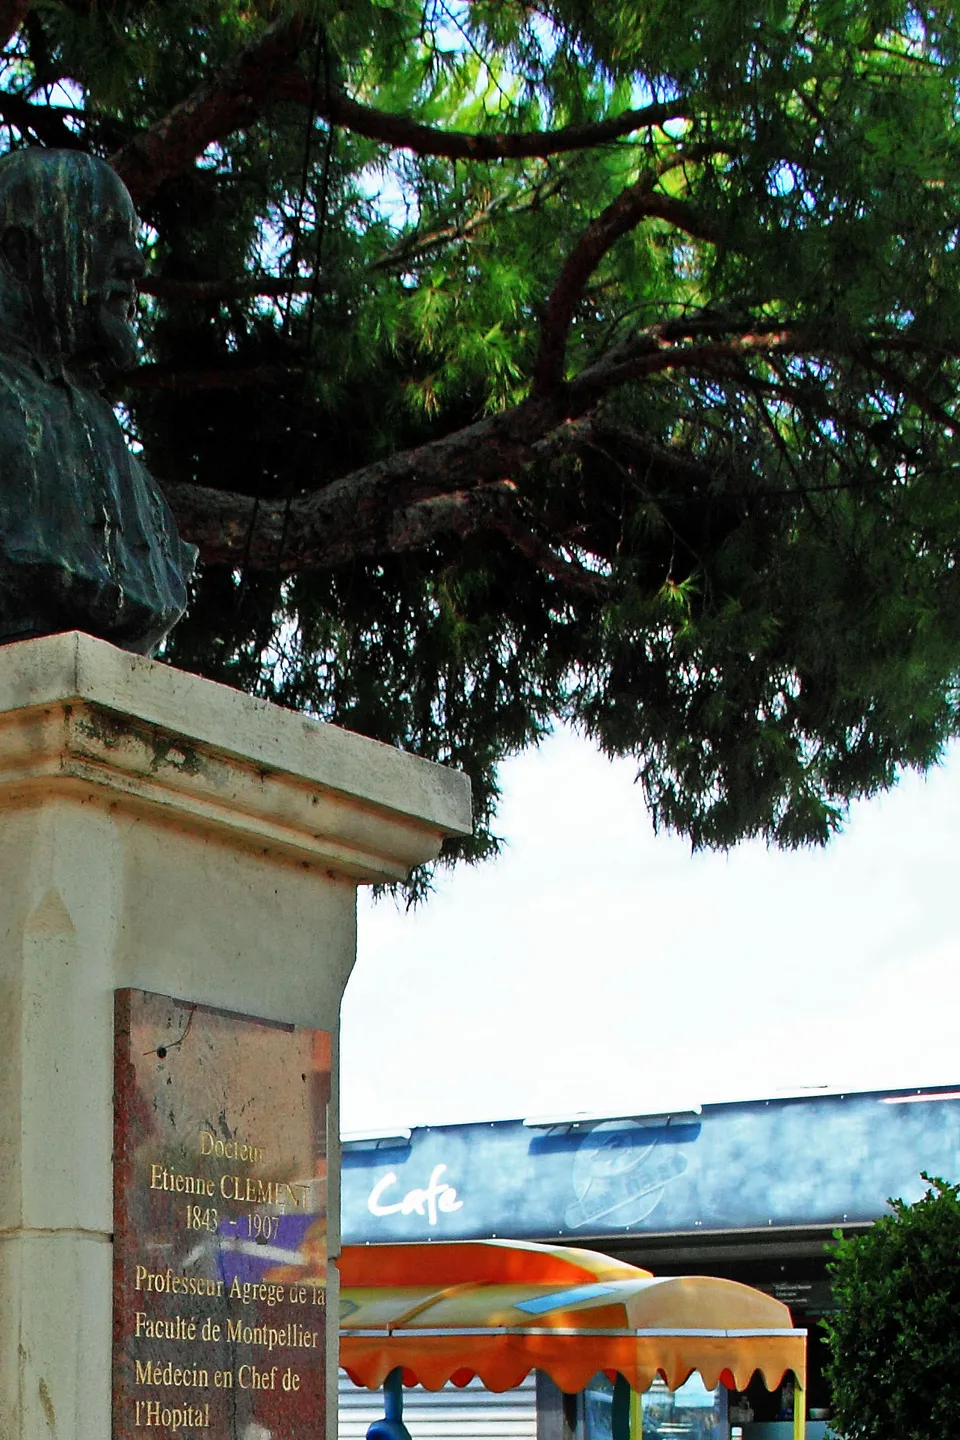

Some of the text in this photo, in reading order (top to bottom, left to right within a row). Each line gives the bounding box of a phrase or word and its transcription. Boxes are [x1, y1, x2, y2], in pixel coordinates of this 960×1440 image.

[200, 1131, 266, 1163] Docteur
[150, 1164, 310, 1209] Etienne CLEMENT
[186, 1205, 218, 1232] 1843
[247, 1213, 280, 1240] 1907
[135, 1265, 222, 1298] Professeur
[290, 1281, 307, 1304] de
[135, 1312, 318, 1350] Faculté de Montpellier
[135, 1359, 300, 1391] Médecin en Chef de
